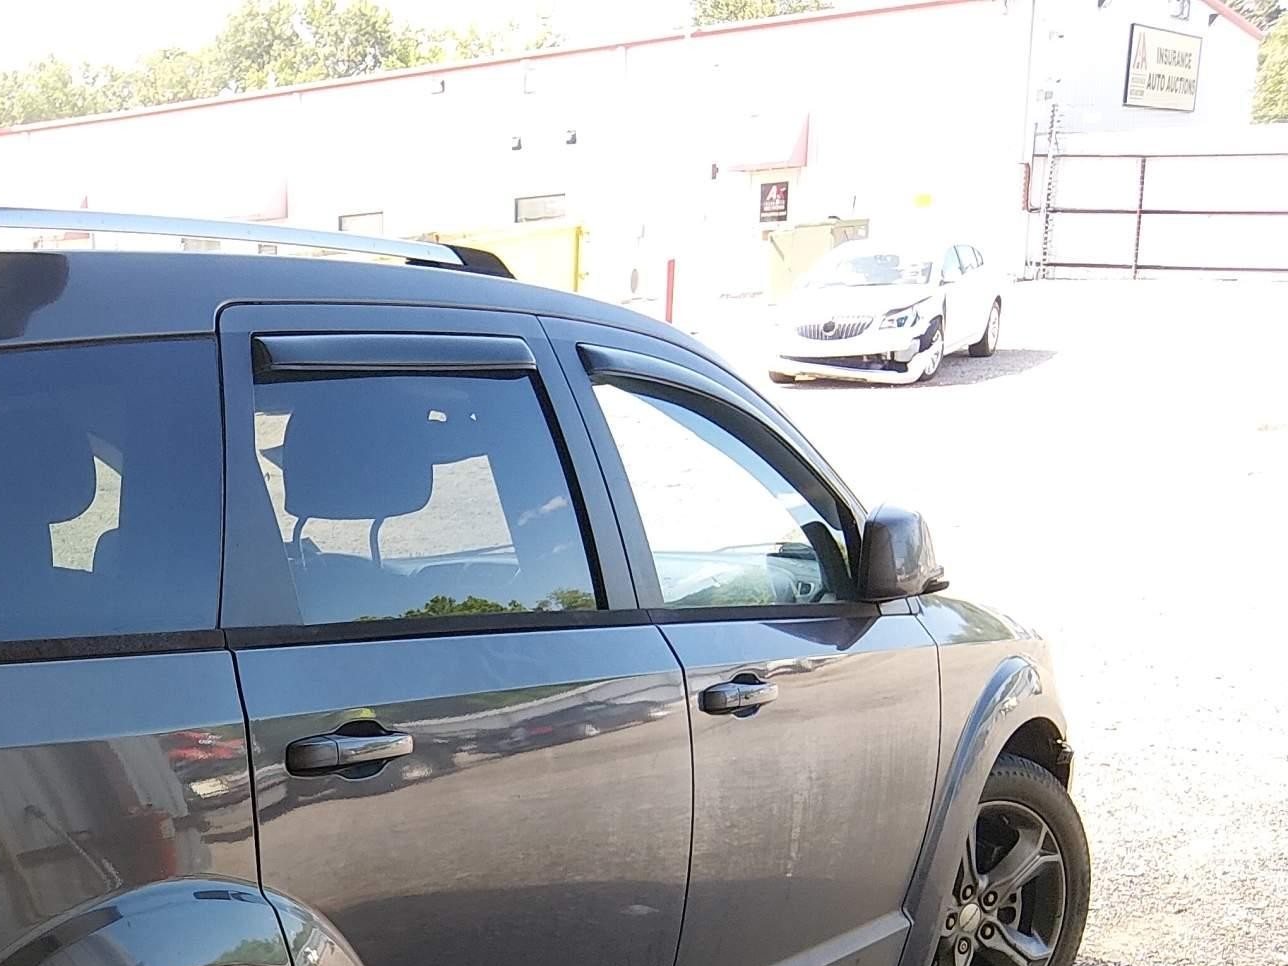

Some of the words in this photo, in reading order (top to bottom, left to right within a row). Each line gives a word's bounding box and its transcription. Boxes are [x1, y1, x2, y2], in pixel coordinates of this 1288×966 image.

[1157, 47, 1192, 70] INSURANCE
[1146, 72, 1165, 91] AUTO
[1165, 74, 1196, 96] AUCTIONS
